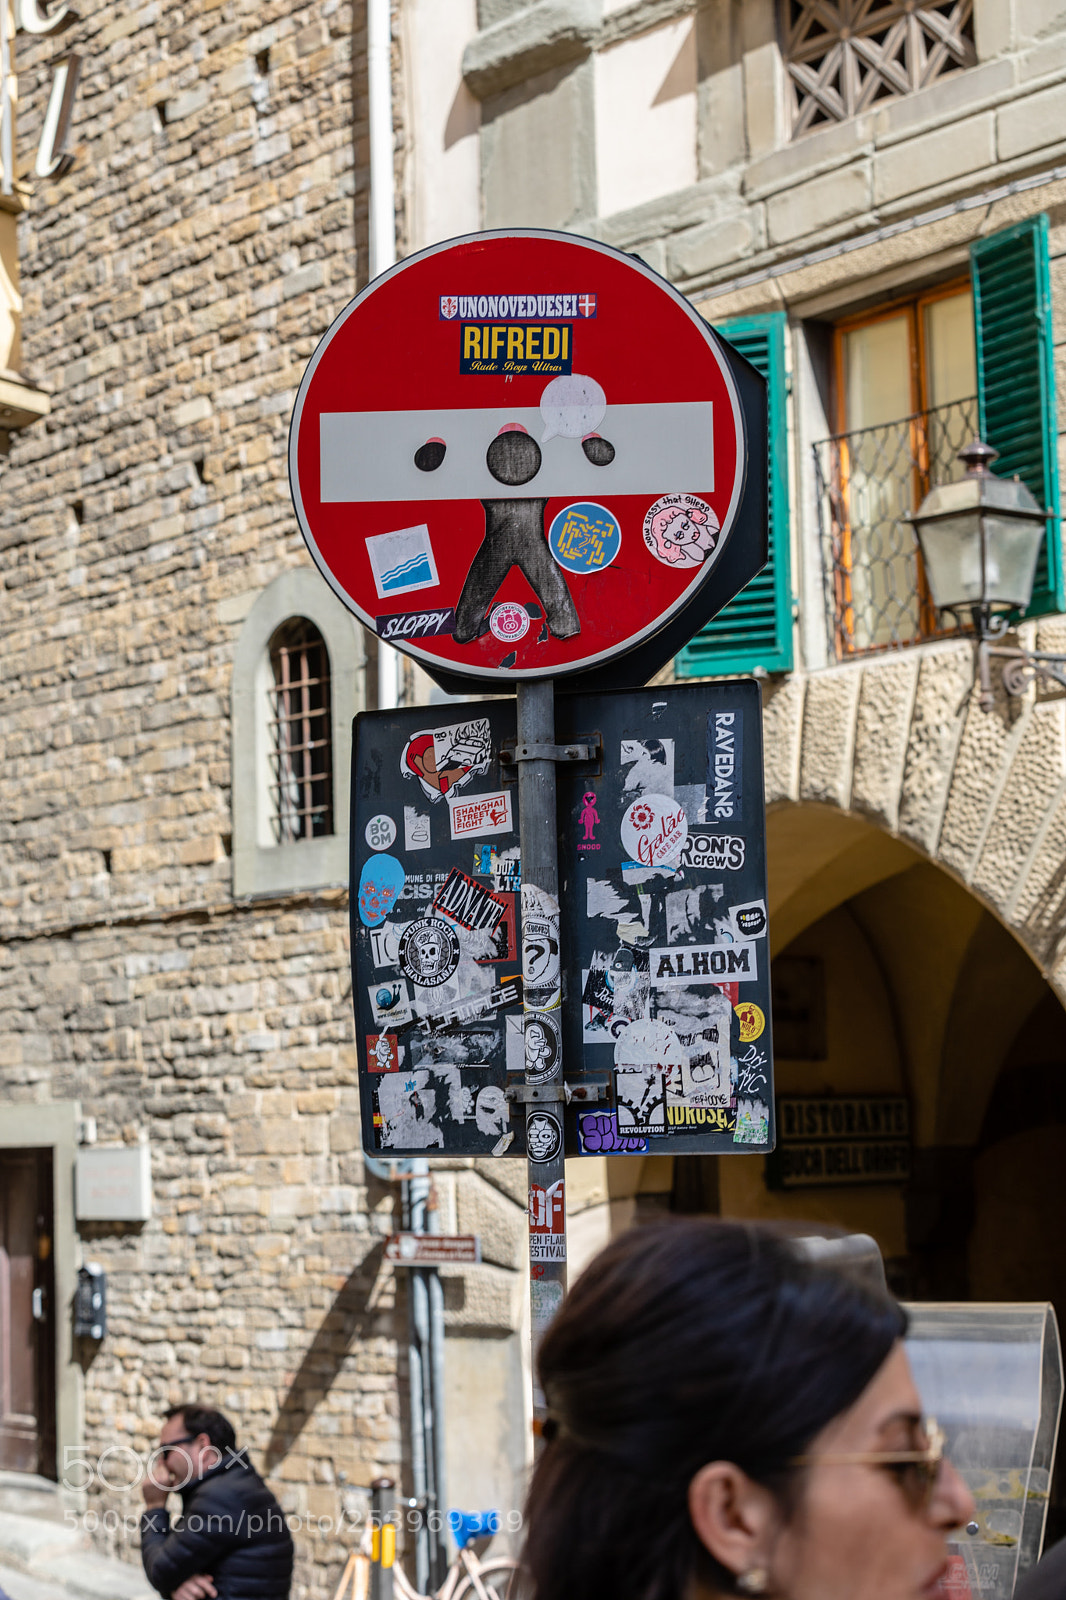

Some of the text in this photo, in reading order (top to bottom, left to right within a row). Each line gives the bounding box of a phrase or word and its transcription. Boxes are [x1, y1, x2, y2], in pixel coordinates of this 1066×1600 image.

[458, 295, 578, 318] UNONOVEDUESEI
[464, 326, 569, 360] RIFREDI
[469, 360, 498, 371] Rude
[532, 360, 562, 371] Ultras
[662, 494, 682, 505] that
[381, 611, 451, 638] SLOPPY
[713, 712, 735, 818] RAVEDANS
[456, 799, 503, 817] SHANGHAI
[456, 810, 490, 824] STREET
[371, 821, 389, 834] BO
[457, 818, 483, 830] FIGHT
[371, 832, 392, 845] OM
[656, 843, 672, 859] CAFE
[669, 830, 682, 844] BAR
[693, 855, 726, 867] crew
[426, 874, 433, 883] DI
[437, 875, 504, 933] ADNATE
[403, 918, 455, 942] PUNK ROCK
[656, 948, 750, 978] ALHOM
[403, 962, 456, 986] MALASANA
[784, 1103, 904, 1135] RISTORANTE
[619, 1125, 665, 1134] REVOLUTION
[529, 1245, 566, 1258] ESTIVAL
